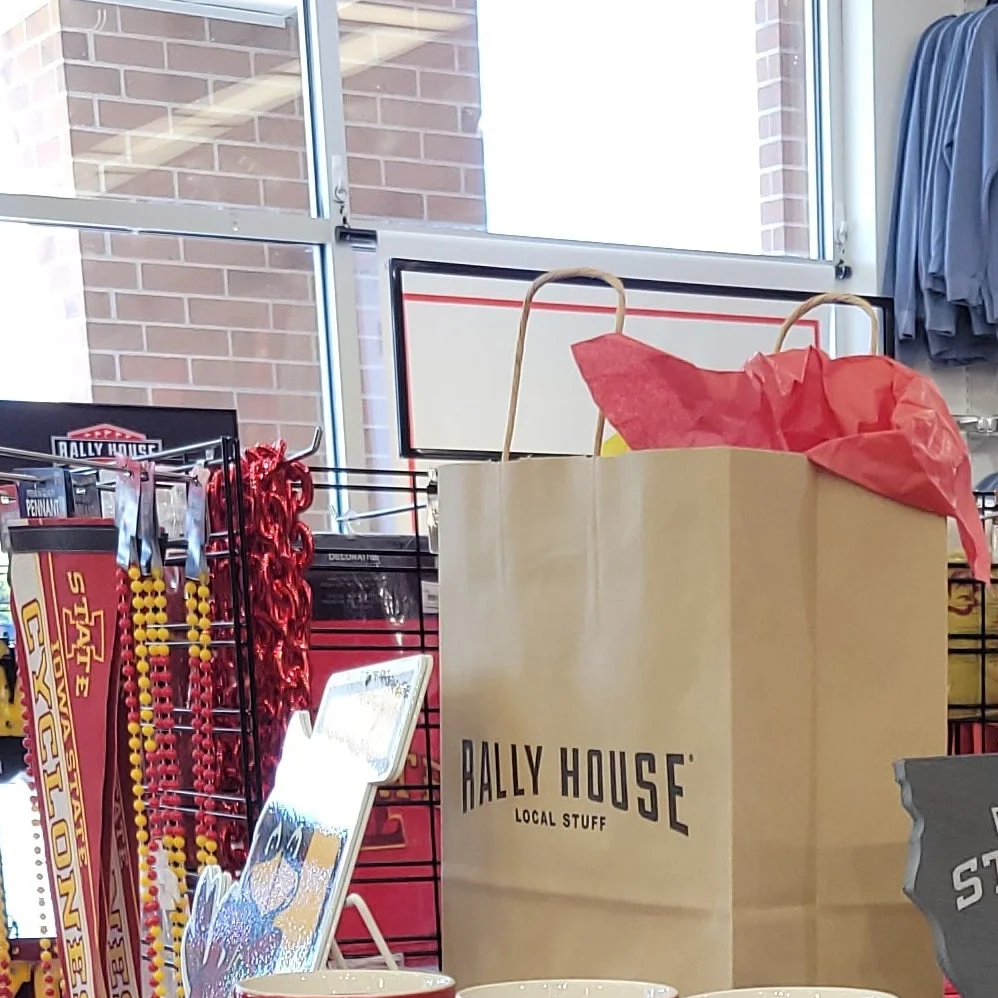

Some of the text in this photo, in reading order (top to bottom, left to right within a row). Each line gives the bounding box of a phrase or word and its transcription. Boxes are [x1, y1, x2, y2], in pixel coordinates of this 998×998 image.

[58, 441, 156, 460] RALLY HOUSE
[66, 571, 93, 698] STATE
[50, 640, 89, 868] IOWA STATE
[462, 739, 543, 815] RALLY
[560, 746, 690, 837] HOUSE
[515, 808, 607, 832] LOCAL STUFF
